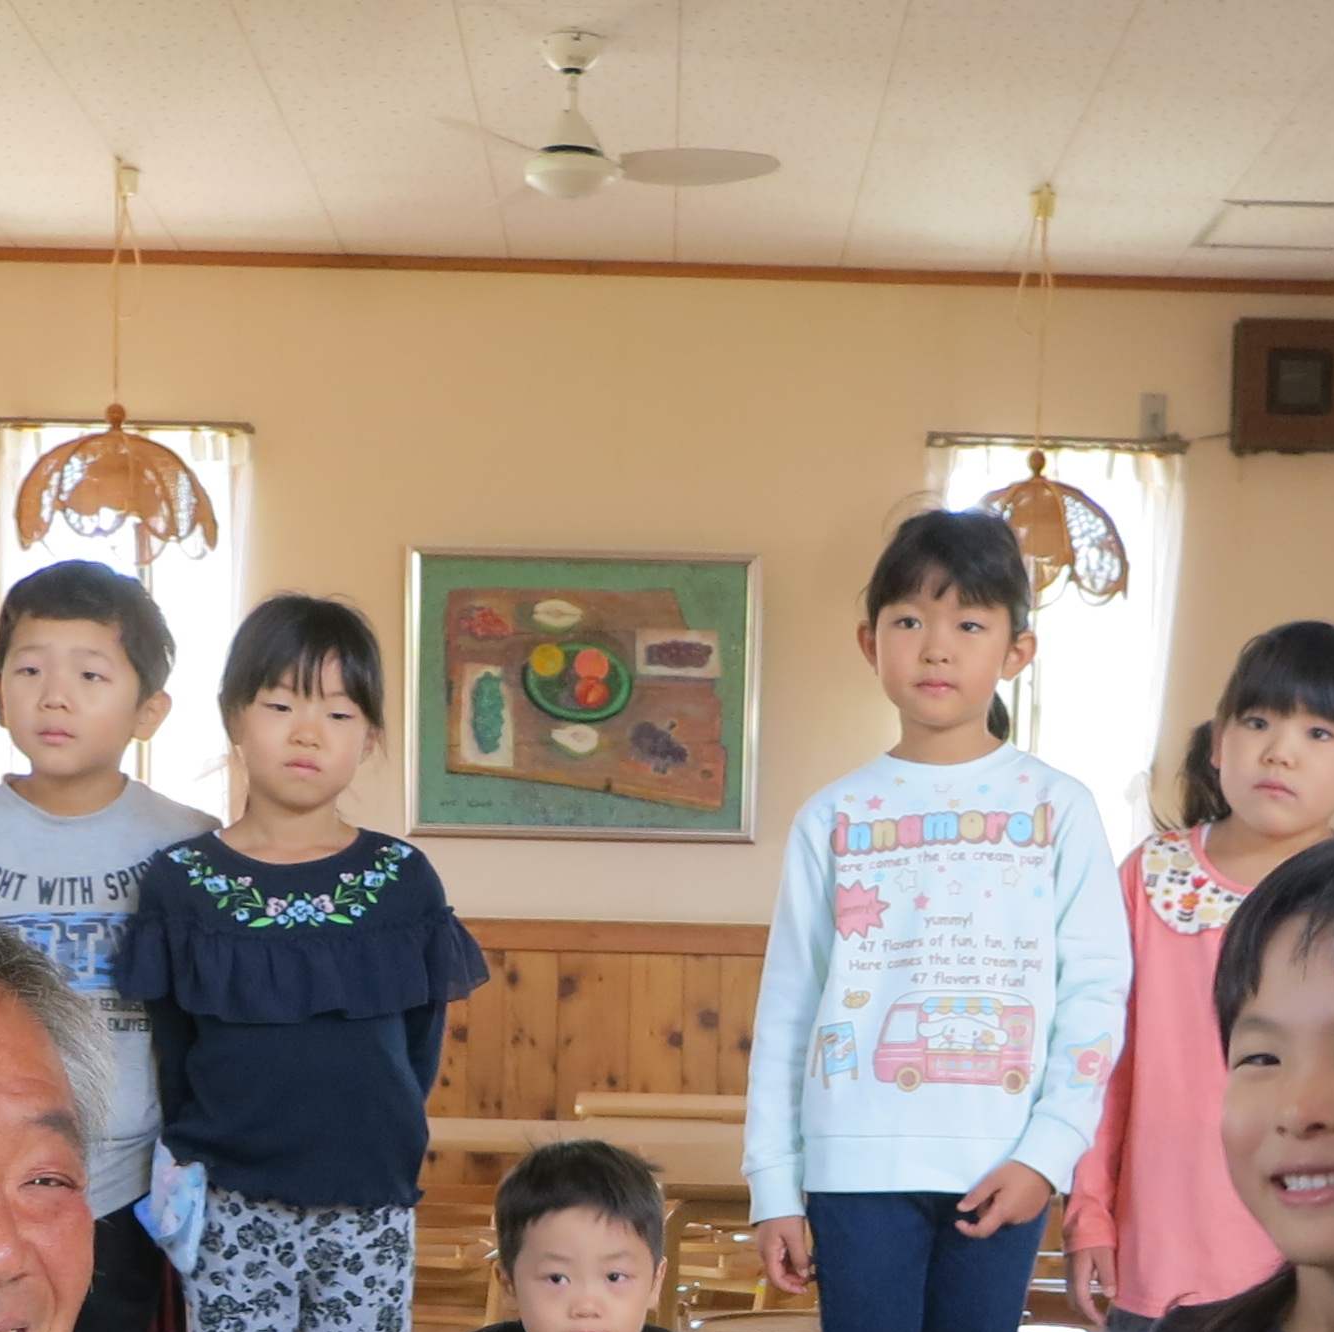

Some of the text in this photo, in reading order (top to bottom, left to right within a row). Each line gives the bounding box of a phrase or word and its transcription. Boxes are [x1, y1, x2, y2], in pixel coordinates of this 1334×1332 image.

[917, 850, 940, 863] the
[972, 851, 1015, 863] cream
[36, 875, 95, 906] WITH
[923, 912, 974, 929] yummy!
[883, 936, 924, 952] flavors
[930, 933, 945, 947] of
[848, 959, 882, 971] Here
[887, 955, 923, 970] comes
[929, 954, 952, 966] the
[957, 954, 976, 965] ice
[982, 956, 1018, 968] cream
[933, 971, 981, 985] flavors
